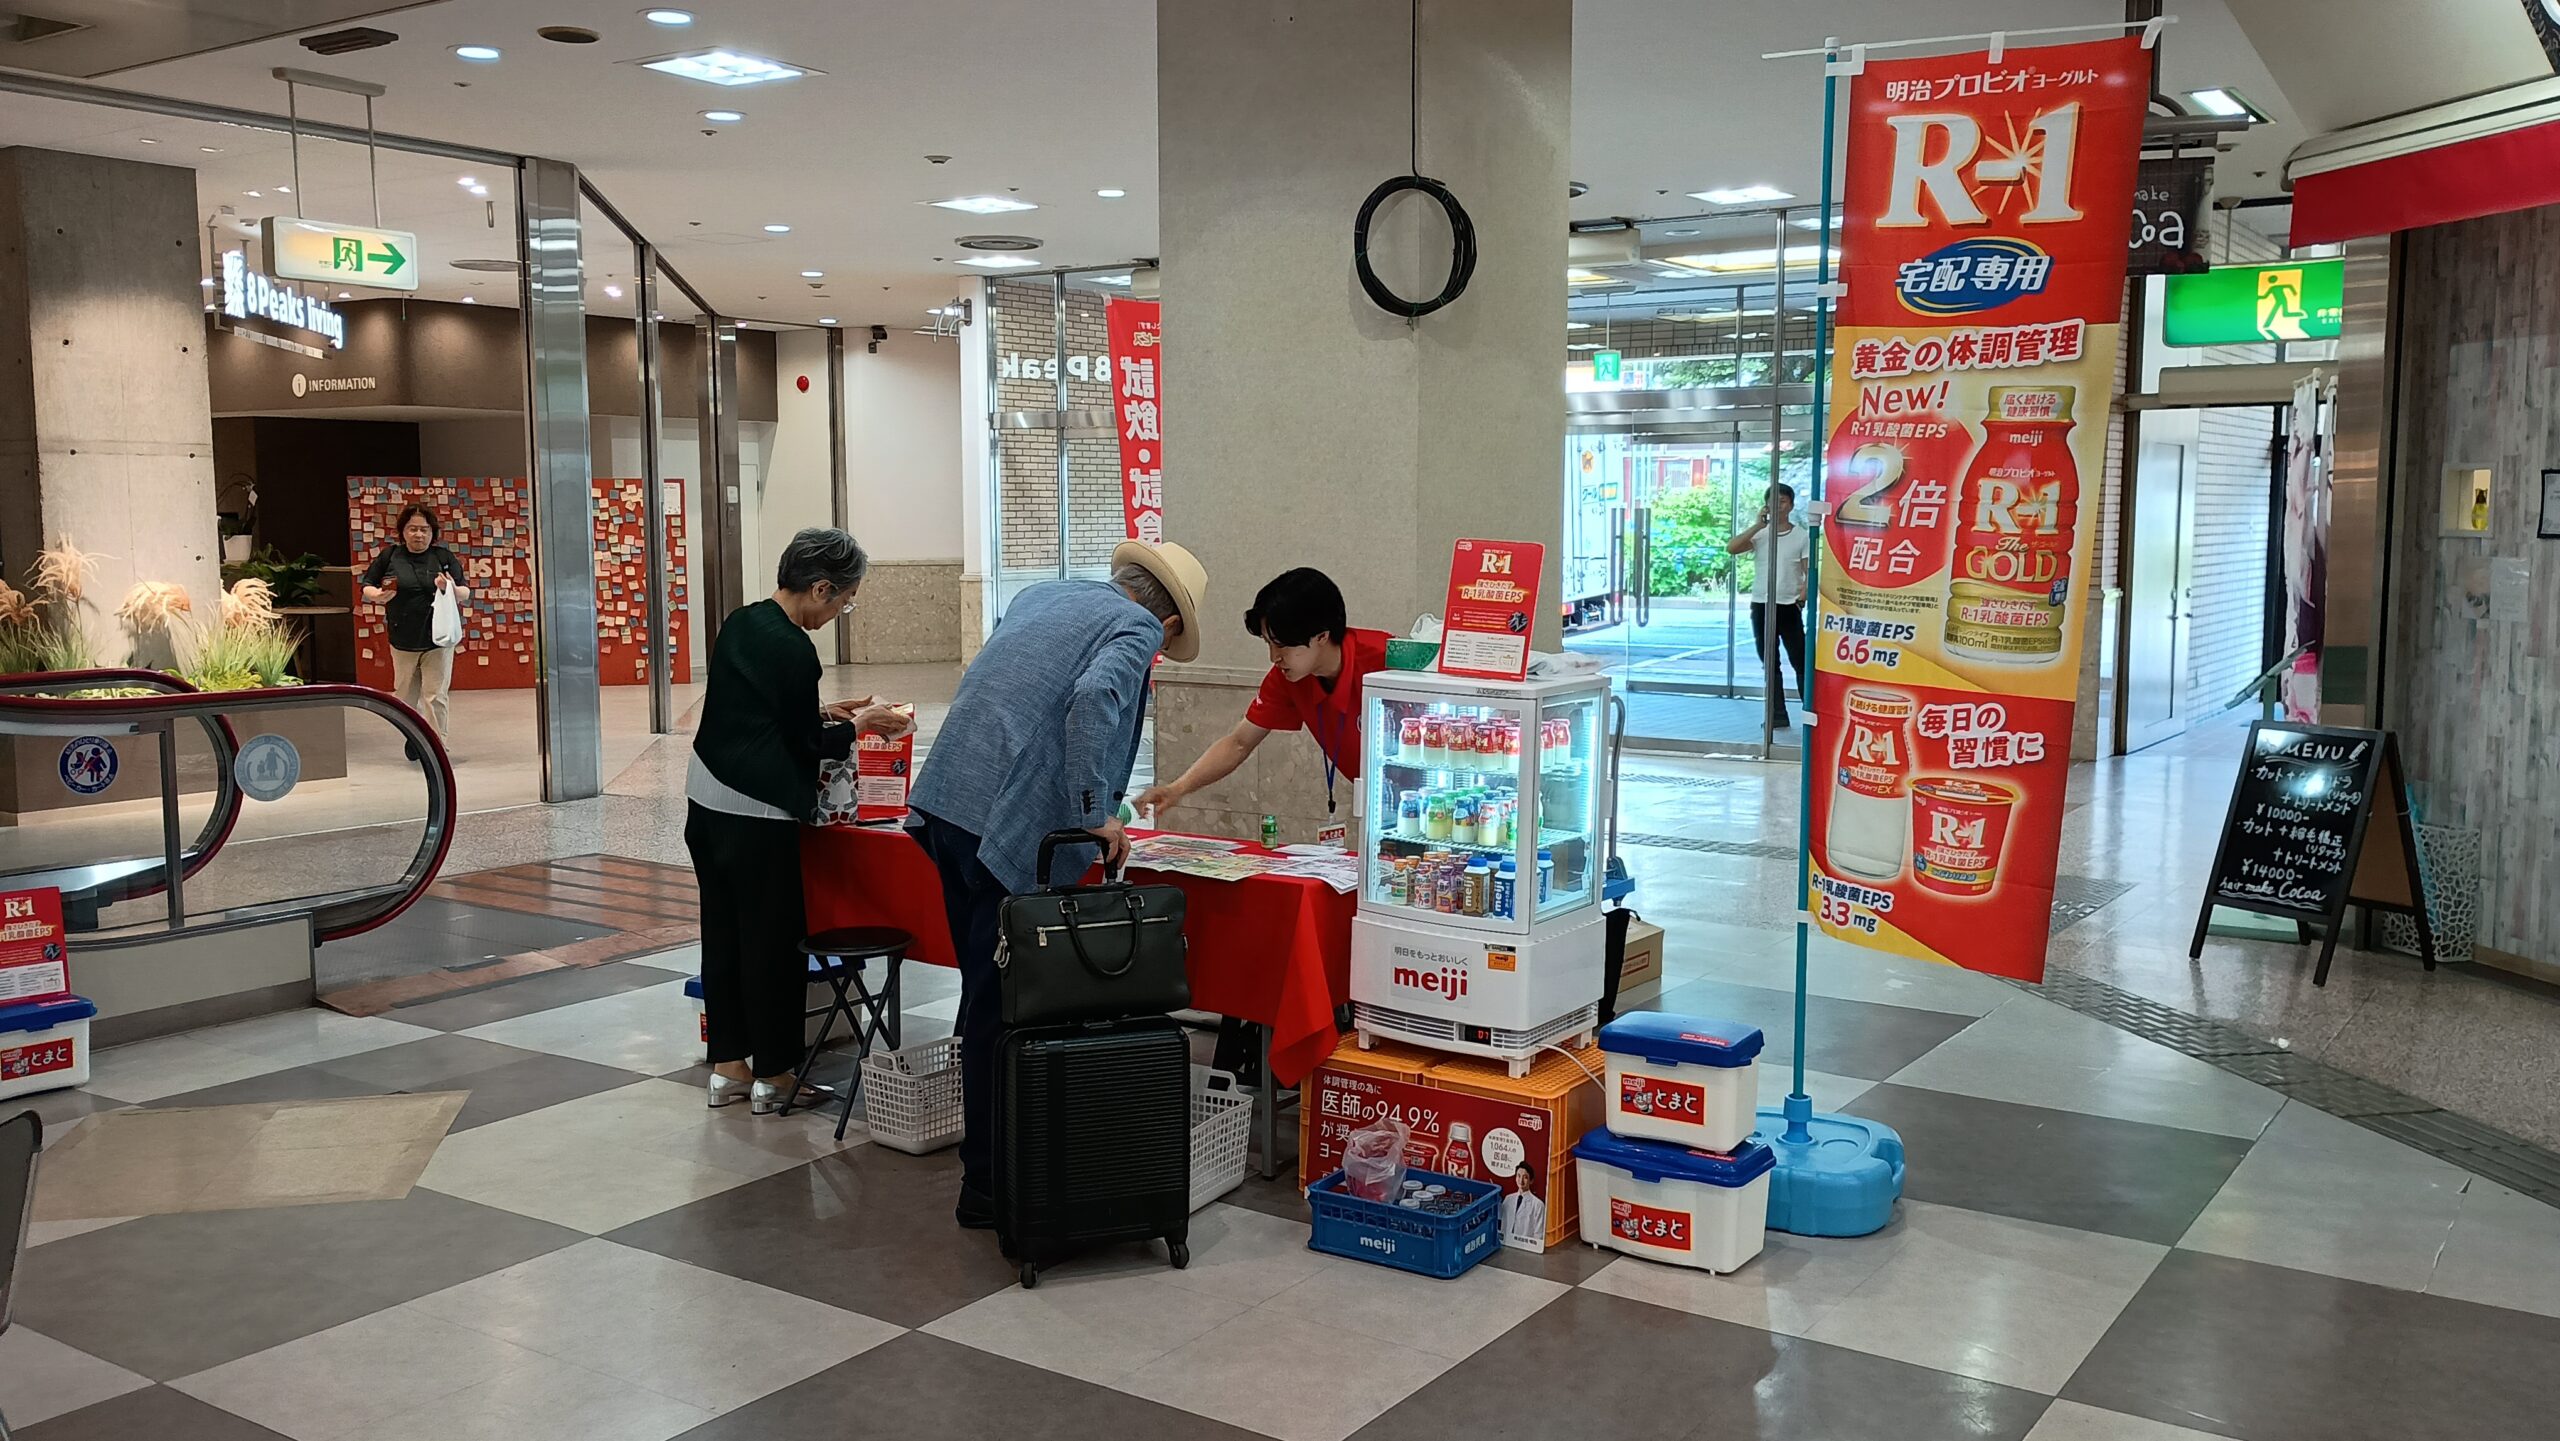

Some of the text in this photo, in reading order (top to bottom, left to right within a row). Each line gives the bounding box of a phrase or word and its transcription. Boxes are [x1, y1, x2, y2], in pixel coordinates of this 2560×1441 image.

[1875, 102, 2085, 229] R-1
[1895, 255, 2051, 293] 宅配専用
[246, 271, 304, 329] 8Peaks
[307, 295, 344, 350] living
[1853, 323, 2081, 375] 黄金の体調管理
[308, 377, 376, 392] INFORMATION
[1861, 380, 1950, 417] New!
[2005, 405, 2052, 418] 健康習慣
[1850, 422, 1947, 439] R-1乳酸菌EPS
[2009, 430, 2044, 447] meiji
[359, 486, 384, 495] FIND
[426, 487, 456, 495] OPEN
[1835, 442, 1947, 529] 2倍
[1970, 479, 2061, 537] R-1
[1848, 535, 1922, 576] 配合
[1995, 536, 2029, 552] The
[469, 558, 514, 578] ISH
[1480, 552, 1513, 574] R-1
[1965, 545, 2058, 583] GOLD
[1463, 587, 1523, 602] R-1乳酸菌EPS
[1824, 614, 1916, 641] R-1乳酸菌EPS
[1960, 606, 2050, 627] R-1乳酸菌EPS
[1836, 635, 1899, 667] 6.6 mg
[1922, 706, 2001, 734] 毎日の
[1848, 724, 1901, 765] R-1
[1951, 735, 2040, 765] 習慣に
[2280, 742, 2344, 761] MENU
[1929, 810, 1986, 849] R-1
[1924, 849, 1986, 868] R-1乳酸菌EPS
[1464, 876, 1475, 907] meiji
[1495, 881, 1505, 912] meiji
[1811, 873, 1892, 910] R-1乳酸菌EPS
[4, 899, 35, 919] R-1
[1820, 895, 1877, 933] 3.3 mg
[1394, 946, 1468, 966] 明日をもっとおいしく
[1394, 966, 1468, 1001] meiji
[31, 1045, 67, 1067] とまと
[1323, 1074, 1382, 1095] 体調管理の為に
[1321, 1089, 1440, 1134] 医師の949%
[1655, 1088, 1697, 1114] とまと
[1519, 1118, 1542, 1131] meiji
[1641, 1214, 1684, 1241] とまと
[1360, 1235, 1396, 1254] meiji
